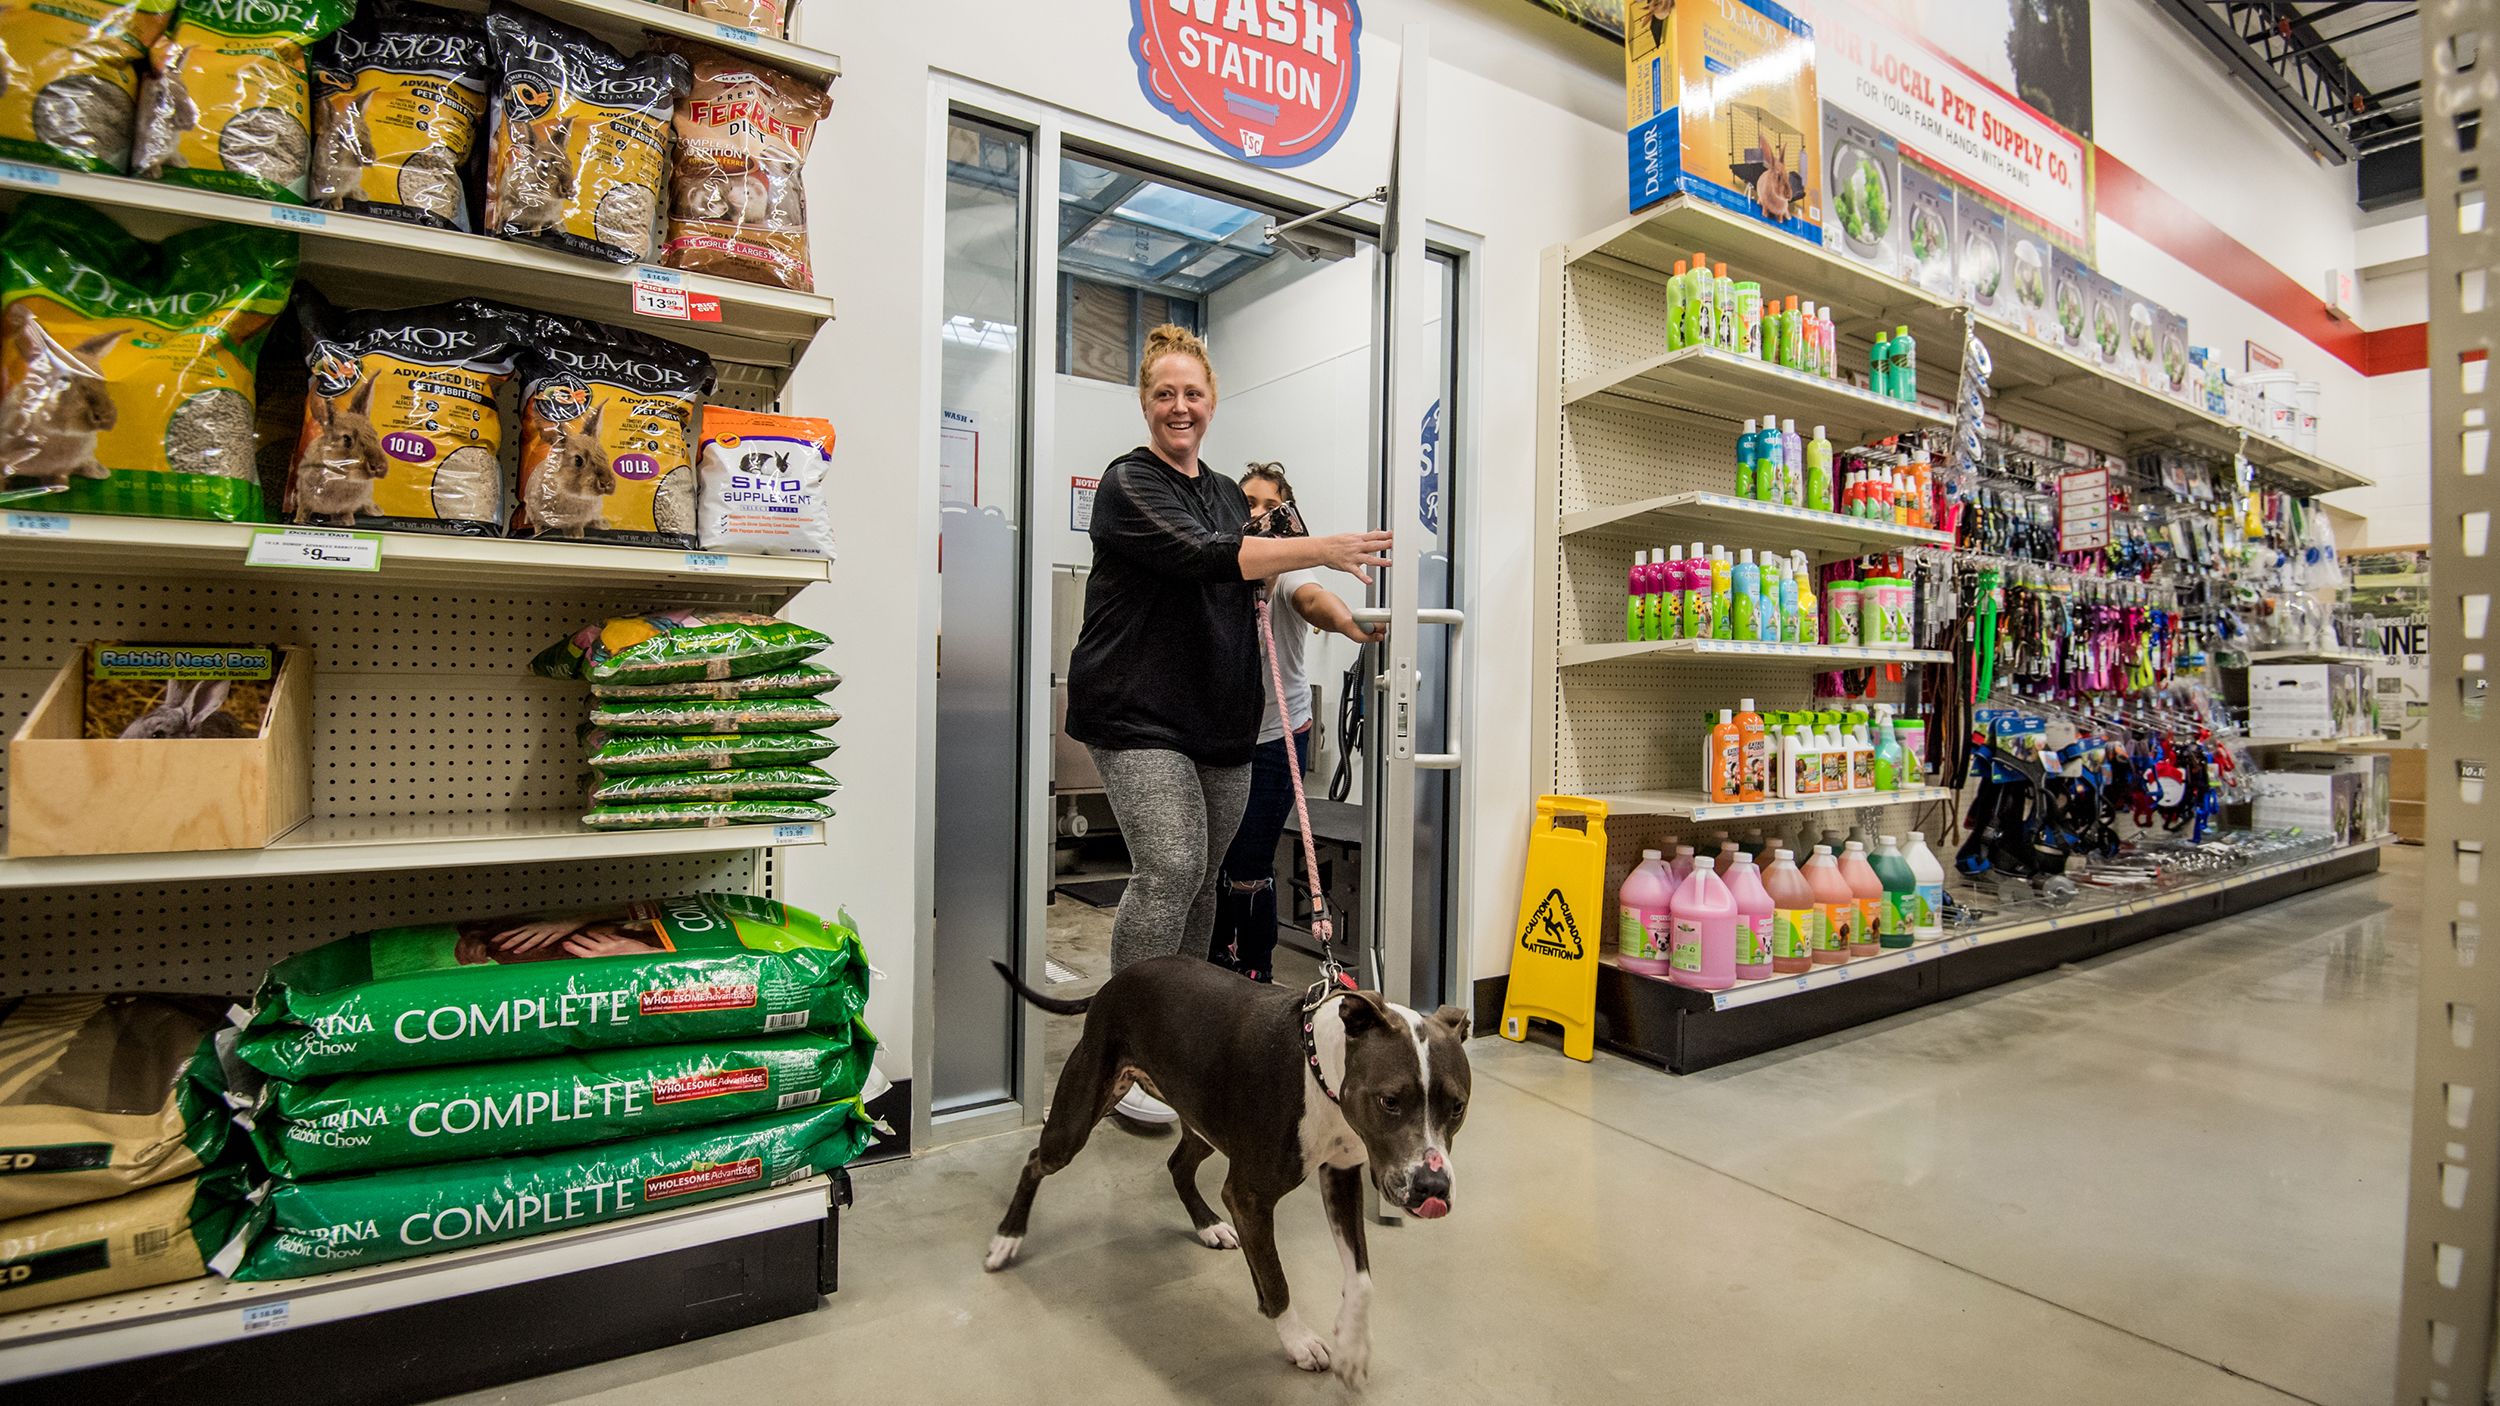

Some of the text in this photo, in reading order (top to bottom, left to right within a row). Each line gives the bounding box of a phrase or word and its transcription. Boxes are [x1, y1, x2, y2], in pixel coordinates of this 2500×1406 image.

[1178, 26, 1321, 110] STATION
[690, 100, 806, 149] FERRET
[1870, 42, 1935, 108] LOCAL
[1940, 83, 1977, 132] PET
[1982, 110, 2043, 172] SUPPLY
[2048, 146, 2072, 189] CO.
[729, 120, 766, 143] DIET
[1242, 130, 1262, 155] TSC
[1856, 76, 2030, 188] FOR YOUR FARM HANDS WITH PAWS
[637, 282, 664, 292] PRICE
[393, 368, 463, 385] ADVANCED
[434, 384, 466, 399] RABBIT
[944, 410, 968, 423] WASH
[389, 436, 427, 458] 10 LB.
[619, 459, 653, 475] 10 LB.
[731, 476, 801, 492] SHO
[1075, 478, 1101, 489] NOTIC
[724, 492, 812, 505] SUPPLEMENT
[288, 530, 325, 538] DOLLAR
[101, 651, 267, 669] Rabbit Nest Box
[140, 670, 176, 679] Sleeping
[178, 670, 197, 679] Spot
[1525, 898, 1582, 945] CAUTION CUIDADO
[1528, 944, 1573, 961] ATTENTION
[643, 992, 705, 1006] WHOLESOME
[394, 989, 630, 1044] COMPLETE
[309, 1040, 358, 1056] Chow
[656, 1078, 717, 1095] WHOLESOME
[717, 1073, 763, 1088] AdvantEdge
[408, 1080, 643, 1138] COMPLETE
[287, 1125, 373, 1149] Rabbit Chow
[648, 1172, 711, 1192] WHOLESOME
[711, 1163, 757, 1180] AdvantEdge
[399, 1177, 636, 1245] COMPLETE
[275, 1234, 364, 1260] Rabbit Chow
